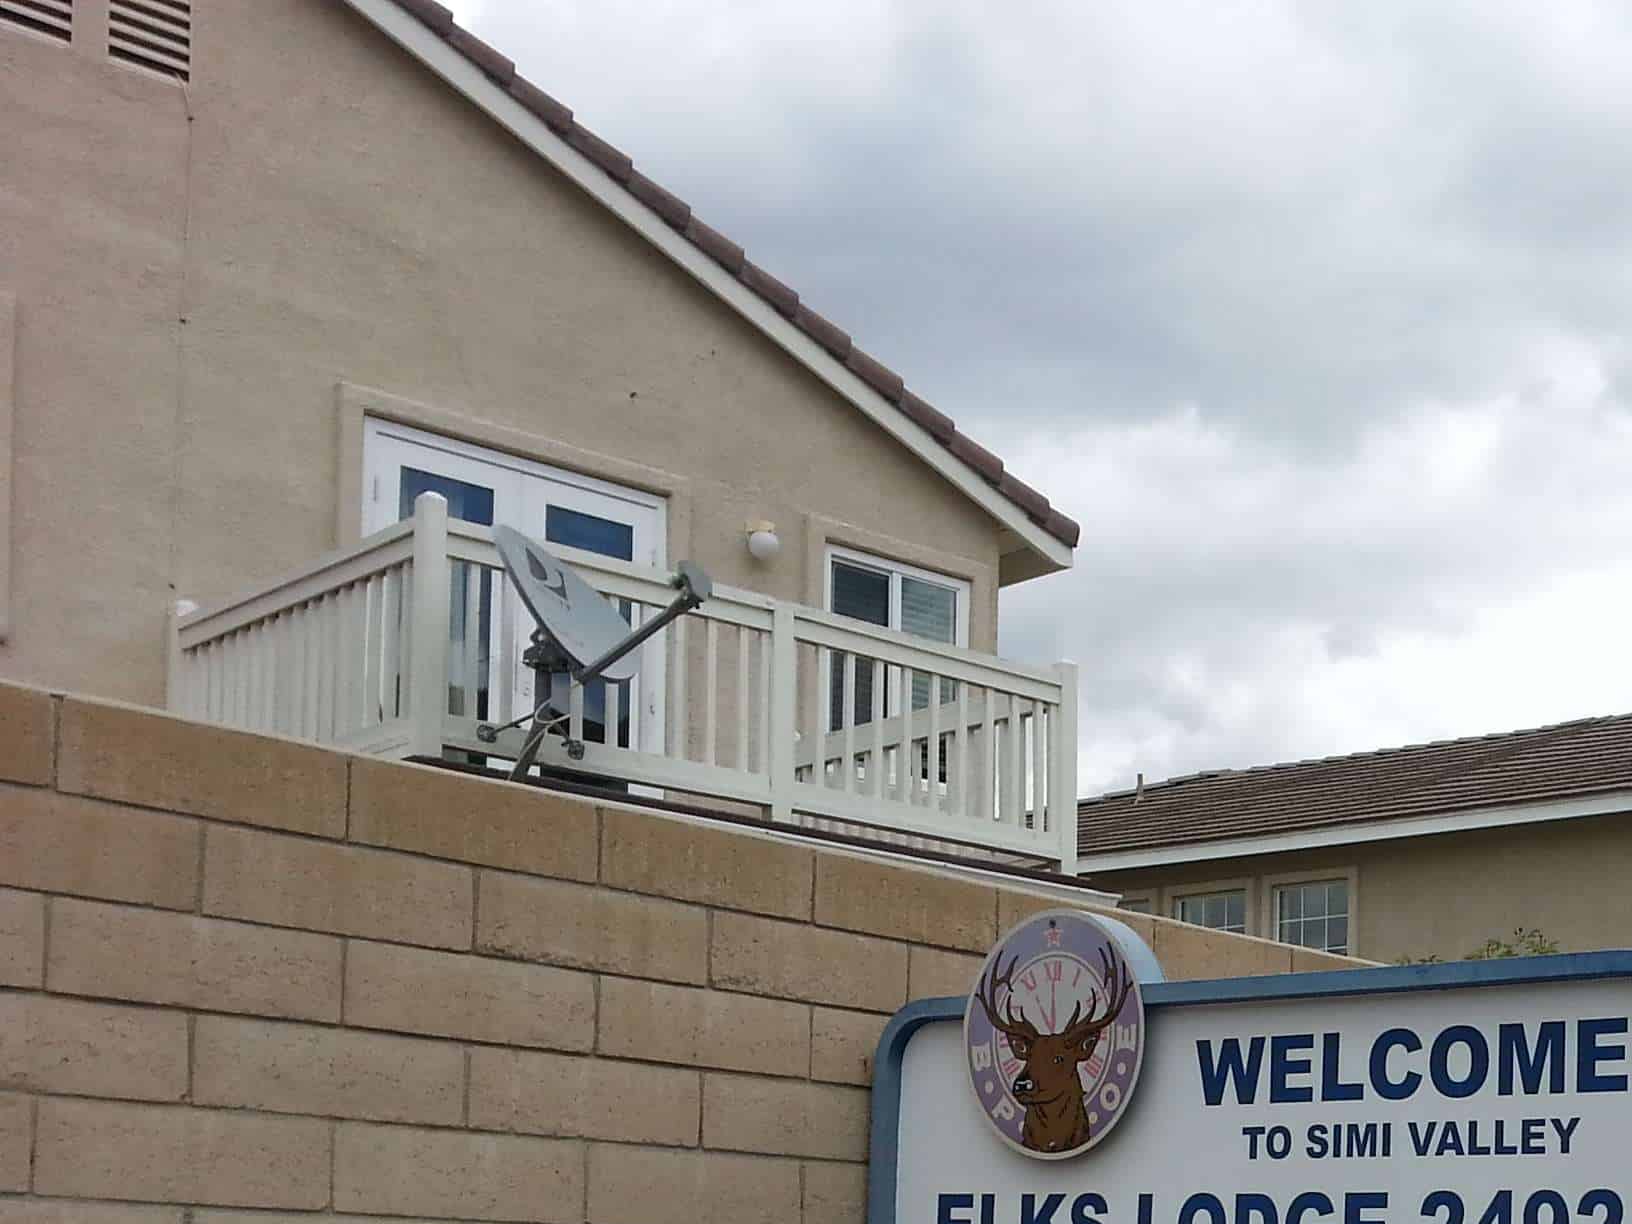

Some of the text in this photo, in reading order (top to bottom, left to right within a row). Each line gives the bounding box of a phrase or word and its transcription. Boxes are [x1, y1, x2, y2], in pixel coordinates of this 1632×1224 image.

[1197, 1016, 1629, 1106] WELCOME
[1242, 1116, 1581, 1160] TO SIMI VALLEY
